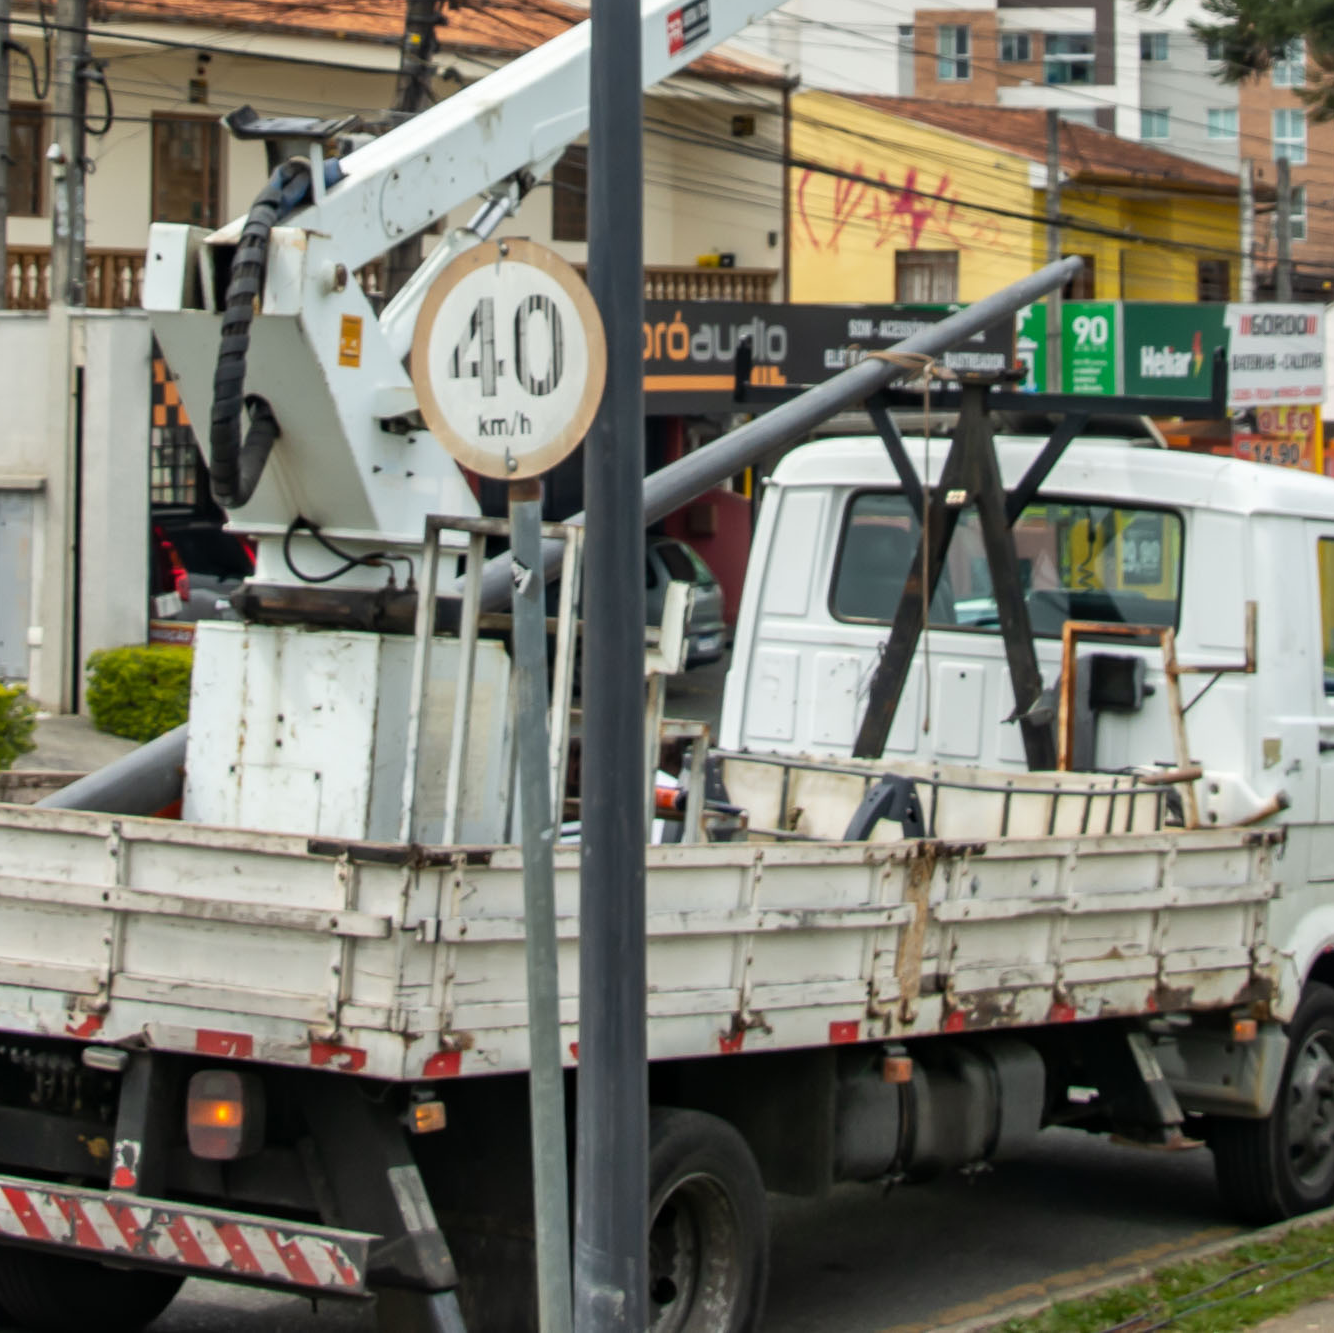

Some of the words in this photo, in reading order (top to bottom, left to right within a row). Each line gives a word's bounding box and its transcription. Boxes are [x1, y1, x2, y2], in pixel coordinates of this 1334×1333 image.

[1072, 315, 1109, 345] 90
[1250, 313, 1308, 335] GORDO
[449, 293, 565, 397] 40
[1140, 345, 1192, 379] Heliar
[478, 411, 532, 437] km/h
